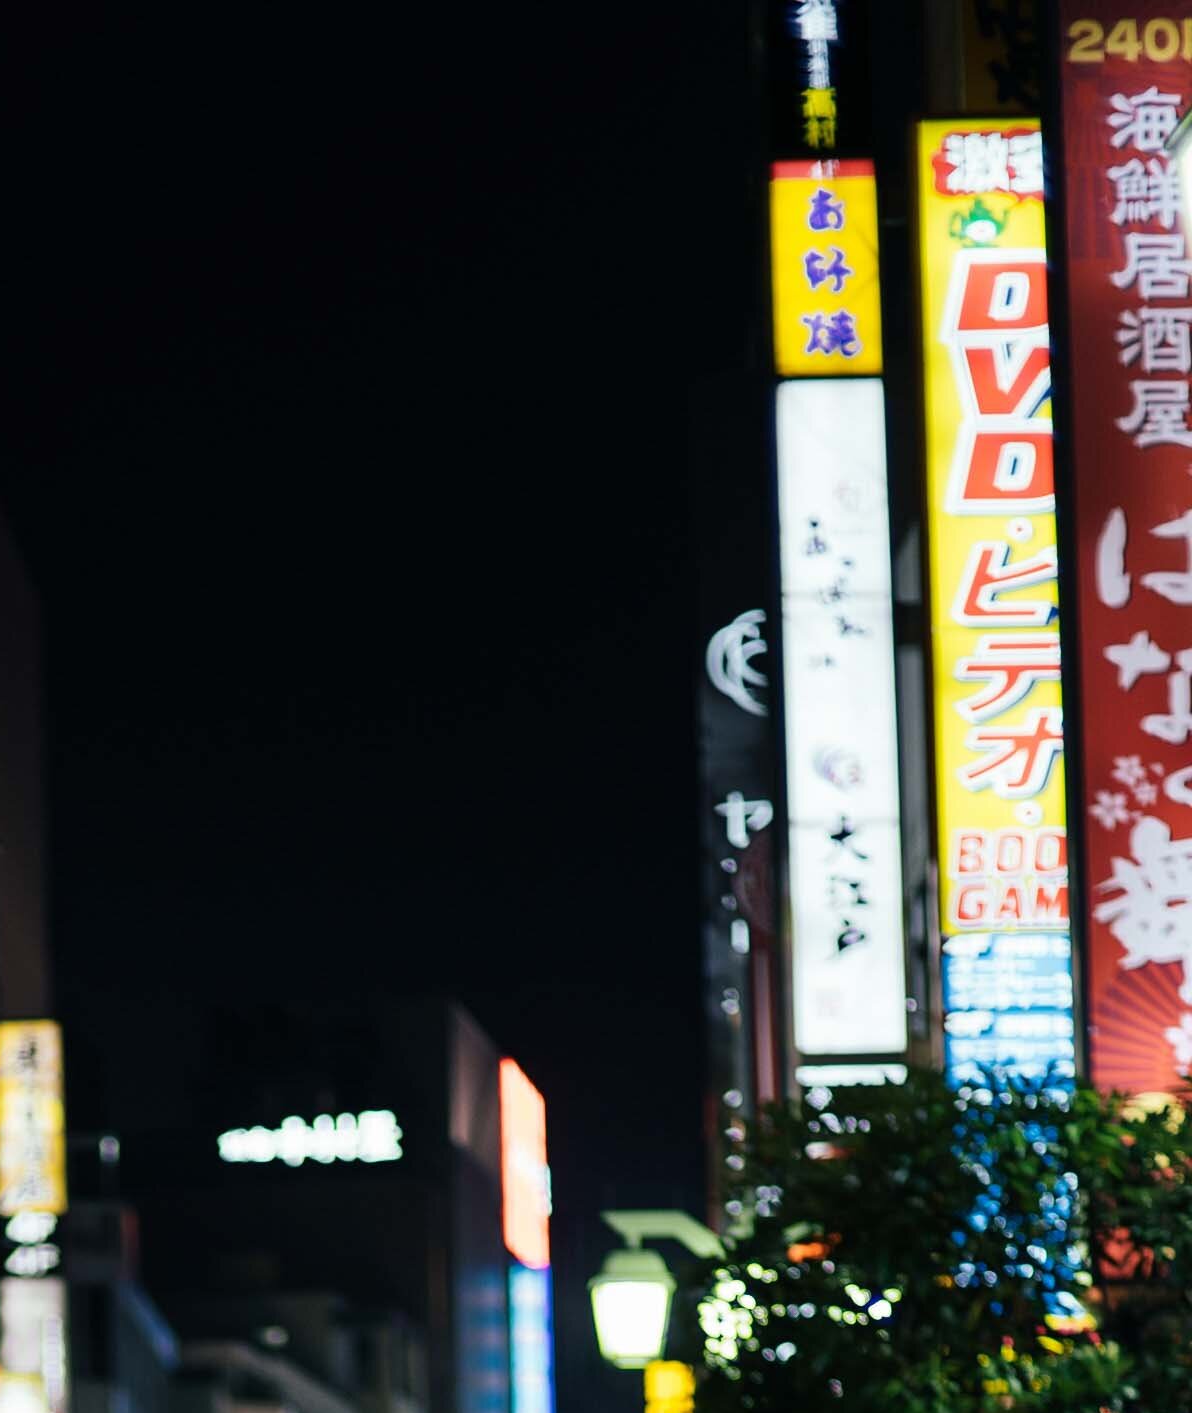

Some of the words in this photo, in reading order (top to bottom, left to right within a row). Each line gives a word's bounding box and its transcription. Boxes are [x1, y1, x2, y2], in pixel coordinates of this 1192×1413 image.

[1067, 17, 1192, 63] 240
[1107, 85, 1192, 448] 海鮮居酒屋
